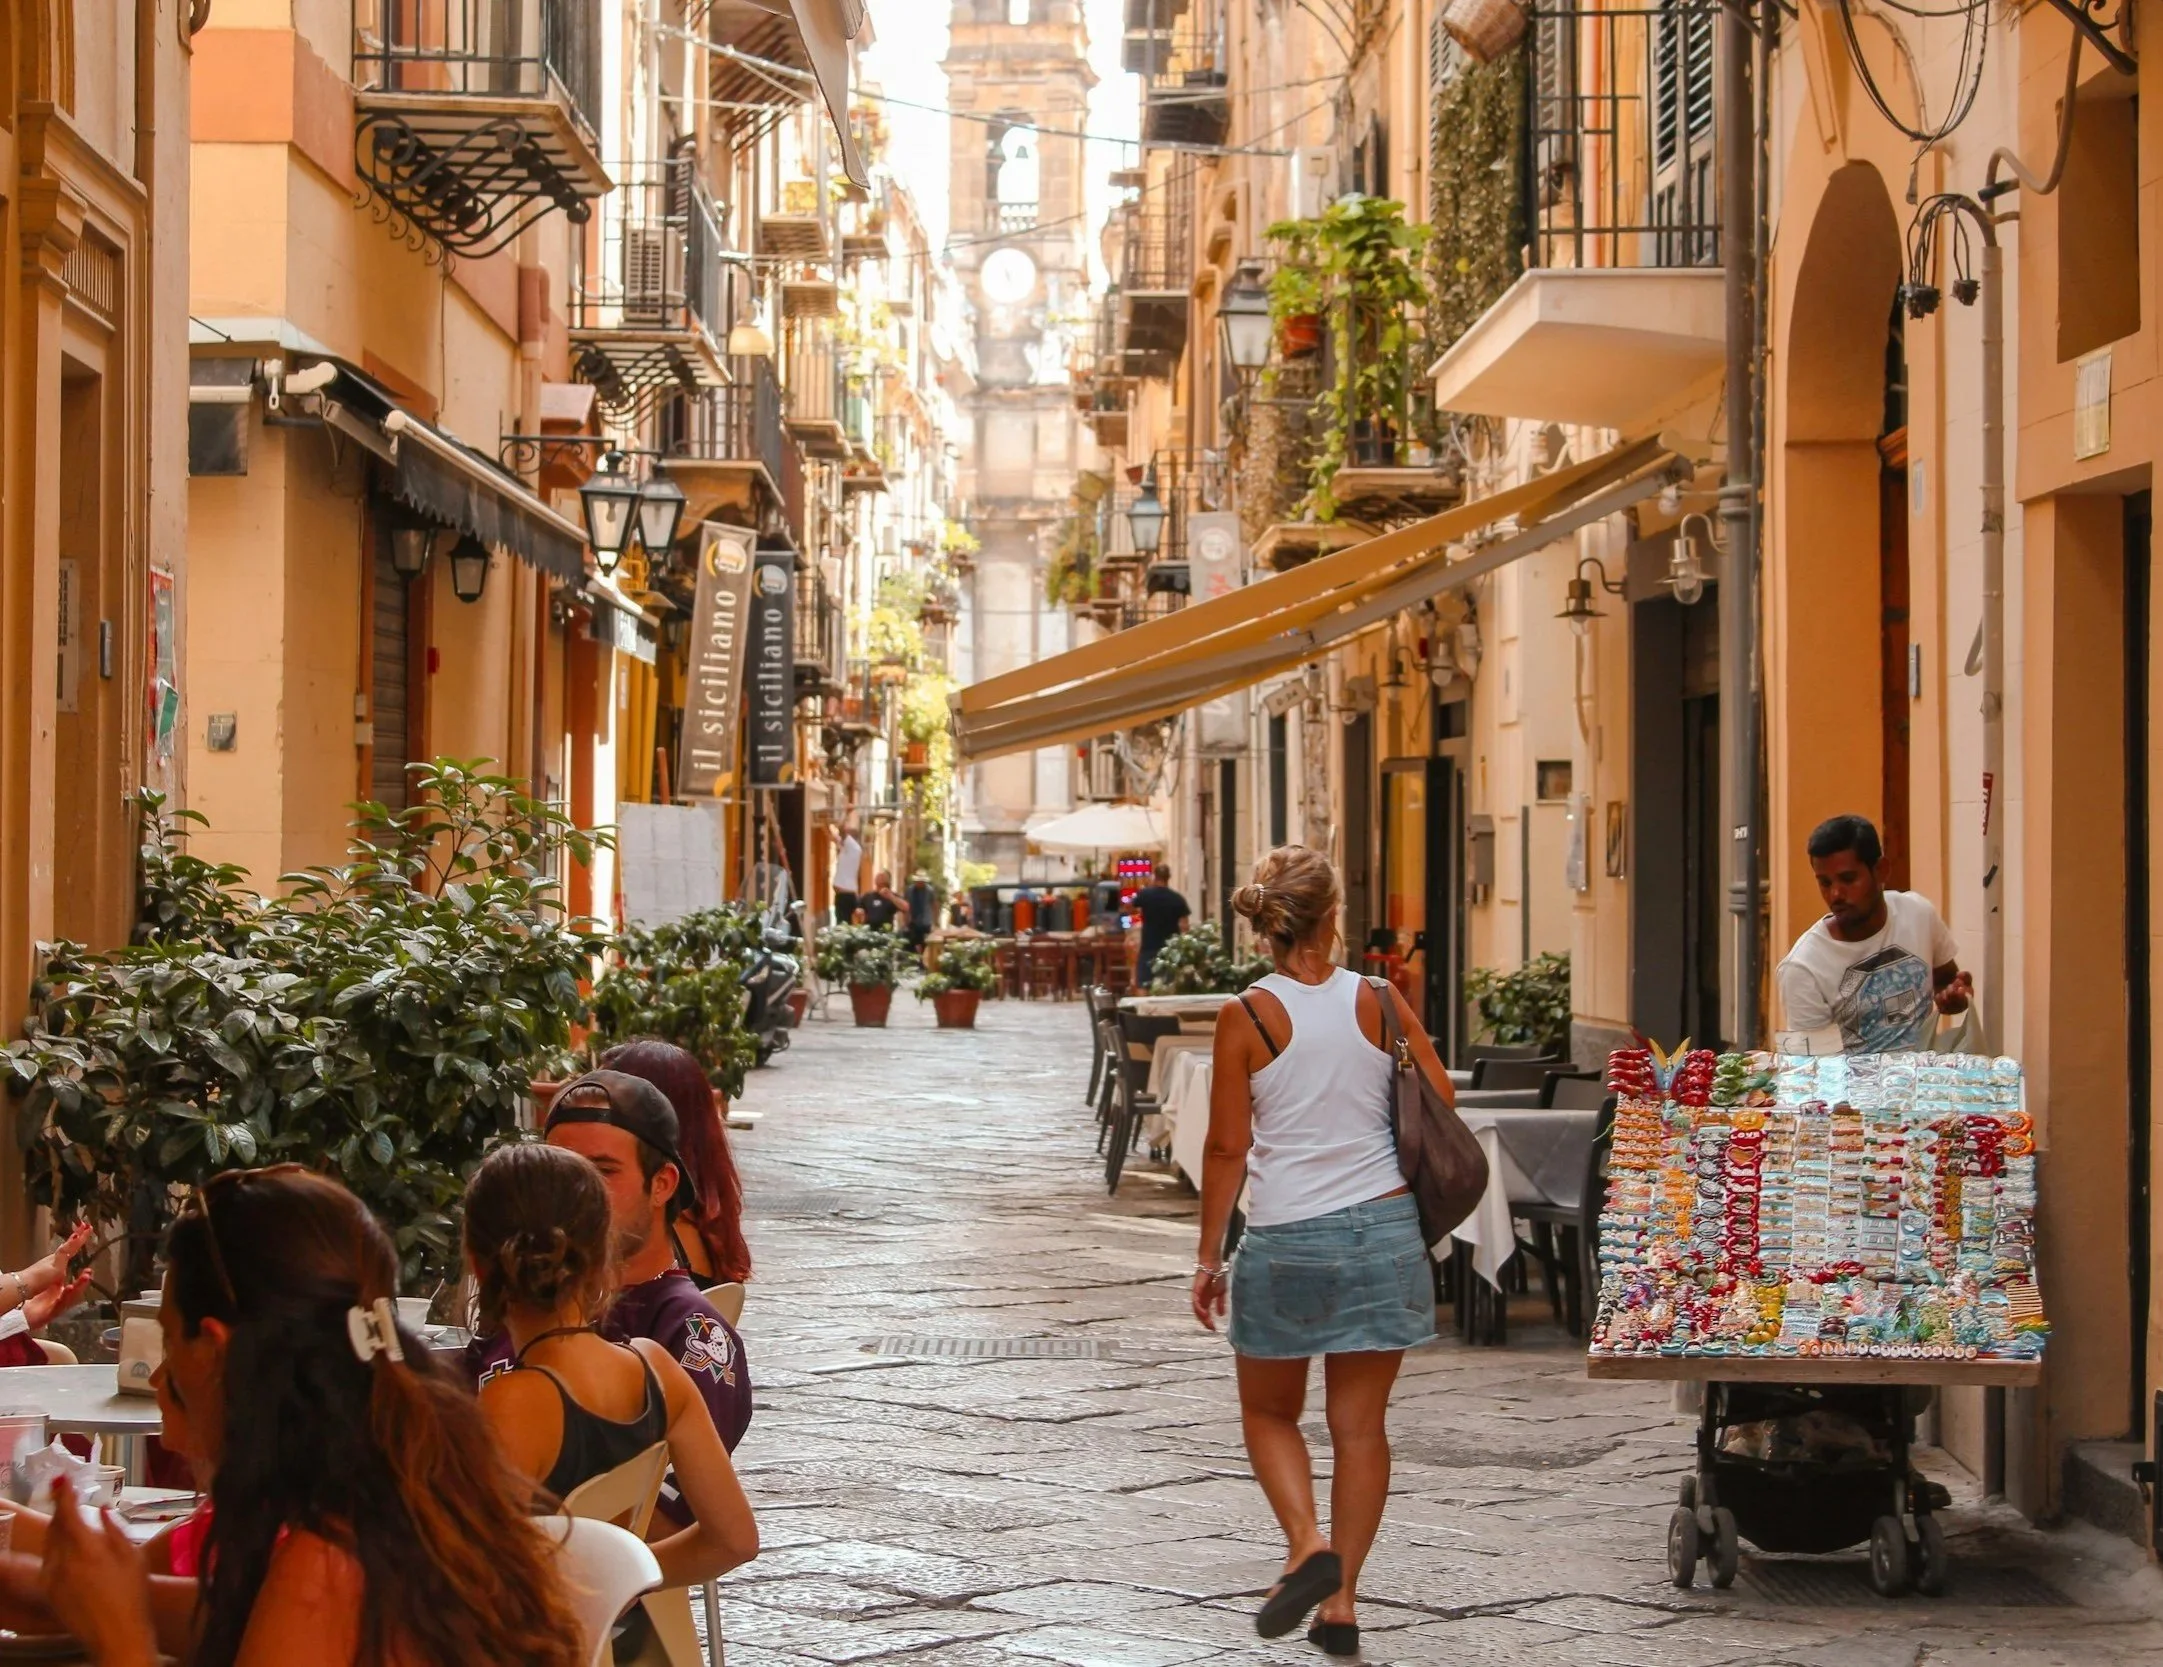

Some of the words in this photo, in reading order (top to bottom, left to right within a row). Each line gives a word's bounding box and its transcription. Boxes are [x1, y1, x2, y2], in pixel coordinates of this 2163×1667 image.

[698, 590, 738, 736] siciliano
[757, 608, 784, 732] siciliano
[692, 748, 722, 771] il
[757, 744, 784, 762] il
[1731, 1131, 1760, 1140] LOVE
